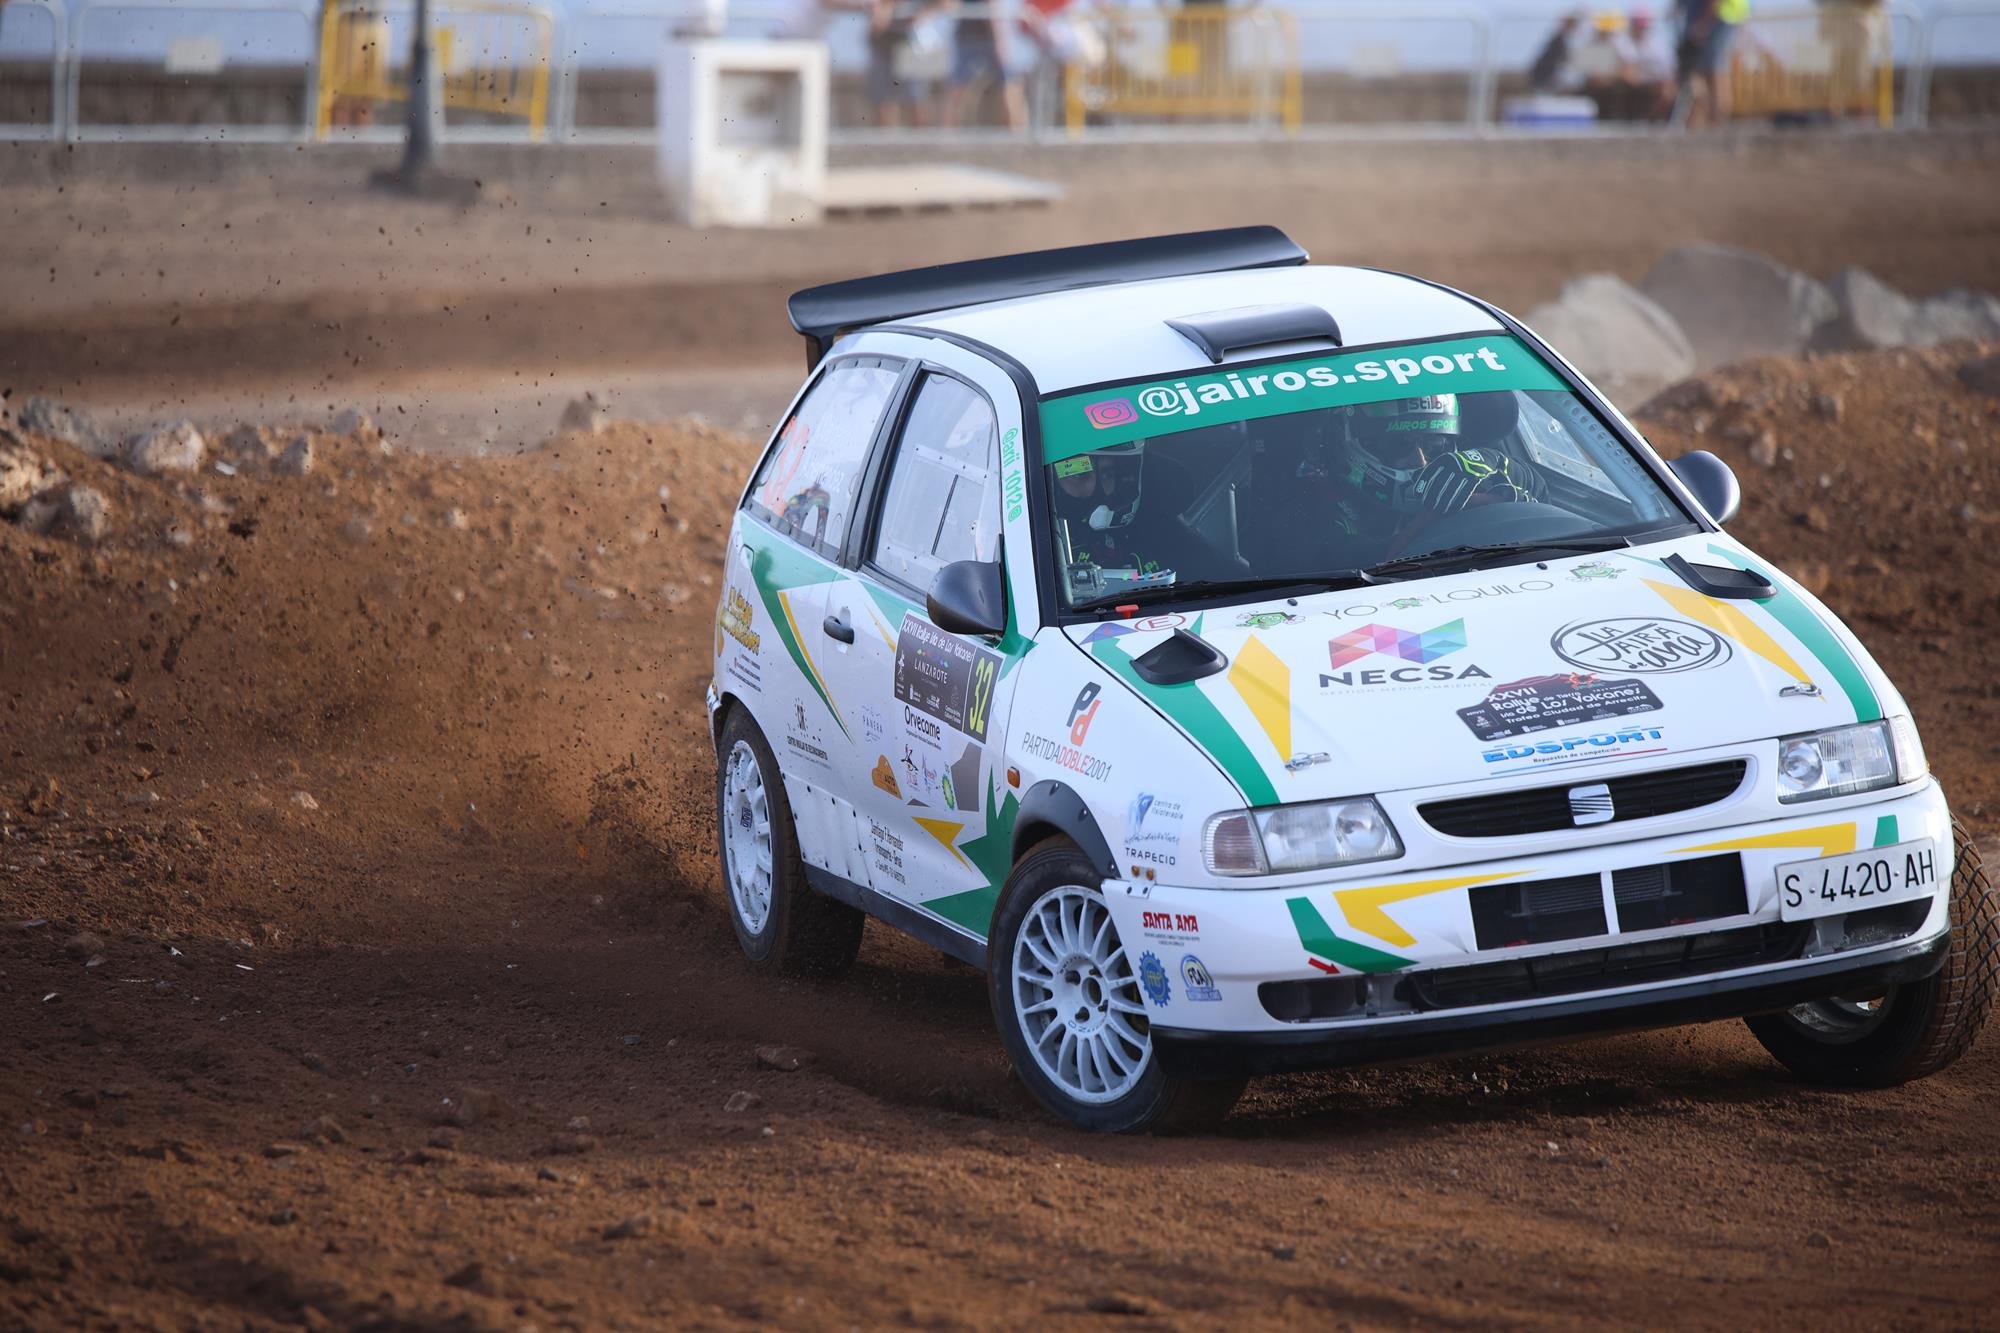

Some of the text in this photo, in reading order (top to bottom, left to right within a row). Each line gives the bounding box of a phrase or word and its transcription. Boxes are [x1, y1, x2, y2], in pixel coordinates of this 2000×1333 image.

[1137, 345, 1507, 416] @jairos.sport
[1386, 420, 1426, 433] JAIROS
[914, 659, 948, 684] LANZAROTE
[1319, 664, 1492, 688] NECSA
[969, 656, 994, 735] 32
[1487, 687, 1538, 702] XXVII
[1491, 697, 1540, 711] Rallye
[1516, 705, 1537, 714] de
[1540, 699, 1568, 710] Los
[1572, 687, 1641, 703] Volcanes
[1505, 713, 1540, 724] Trofeo
[1542, 705, 1585, 716] Ciudad
[1605, 695, 1648, 706] Arrecife
[1481, 725, 1664, 763] EDSPORT
[1022, 732, 1112, 783] PARTIDADOBLE2001
[1125, 847, 1176, 866] TRAPECIO
[1143, 911, 1199, 932] SANTA ANA
